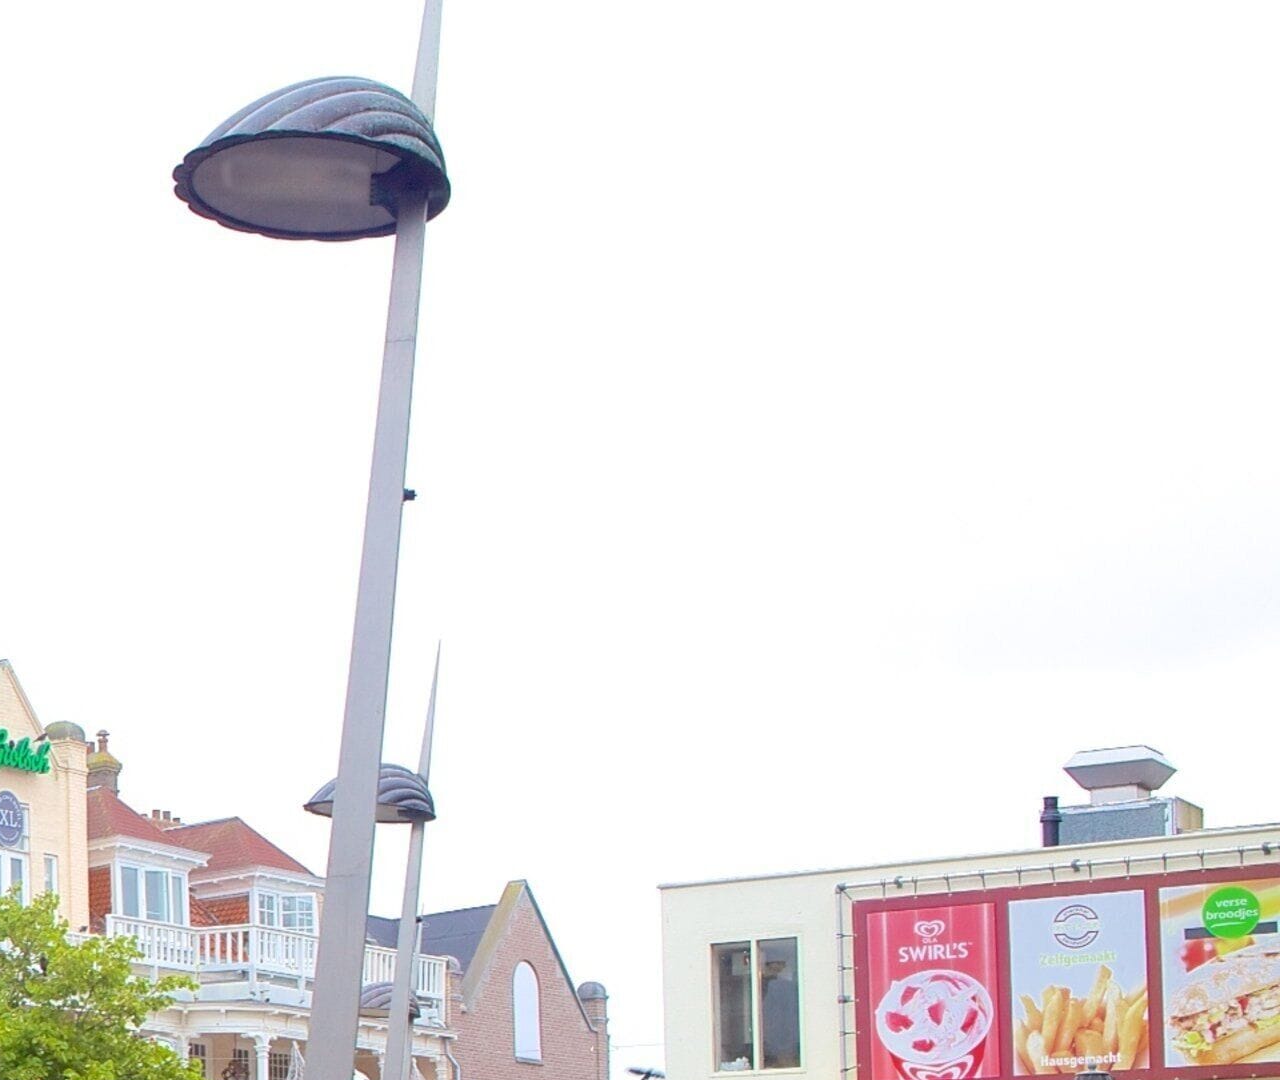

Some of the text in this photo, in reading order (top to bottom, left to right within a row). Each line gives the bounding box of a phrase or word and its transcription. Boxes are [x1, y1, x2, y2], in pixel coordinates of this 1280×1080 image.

[0, 809, 18, 828] XL
[1215, 898, 1248, 908] verse
[1206, 908, 1258, 920] broodjes
[898, 942, 969, 963] SWIRL'S
[1040, 950, 1117, 968] Zelfgemaakt
[1040, 1051, 1123, 1067] Hausgemacht
